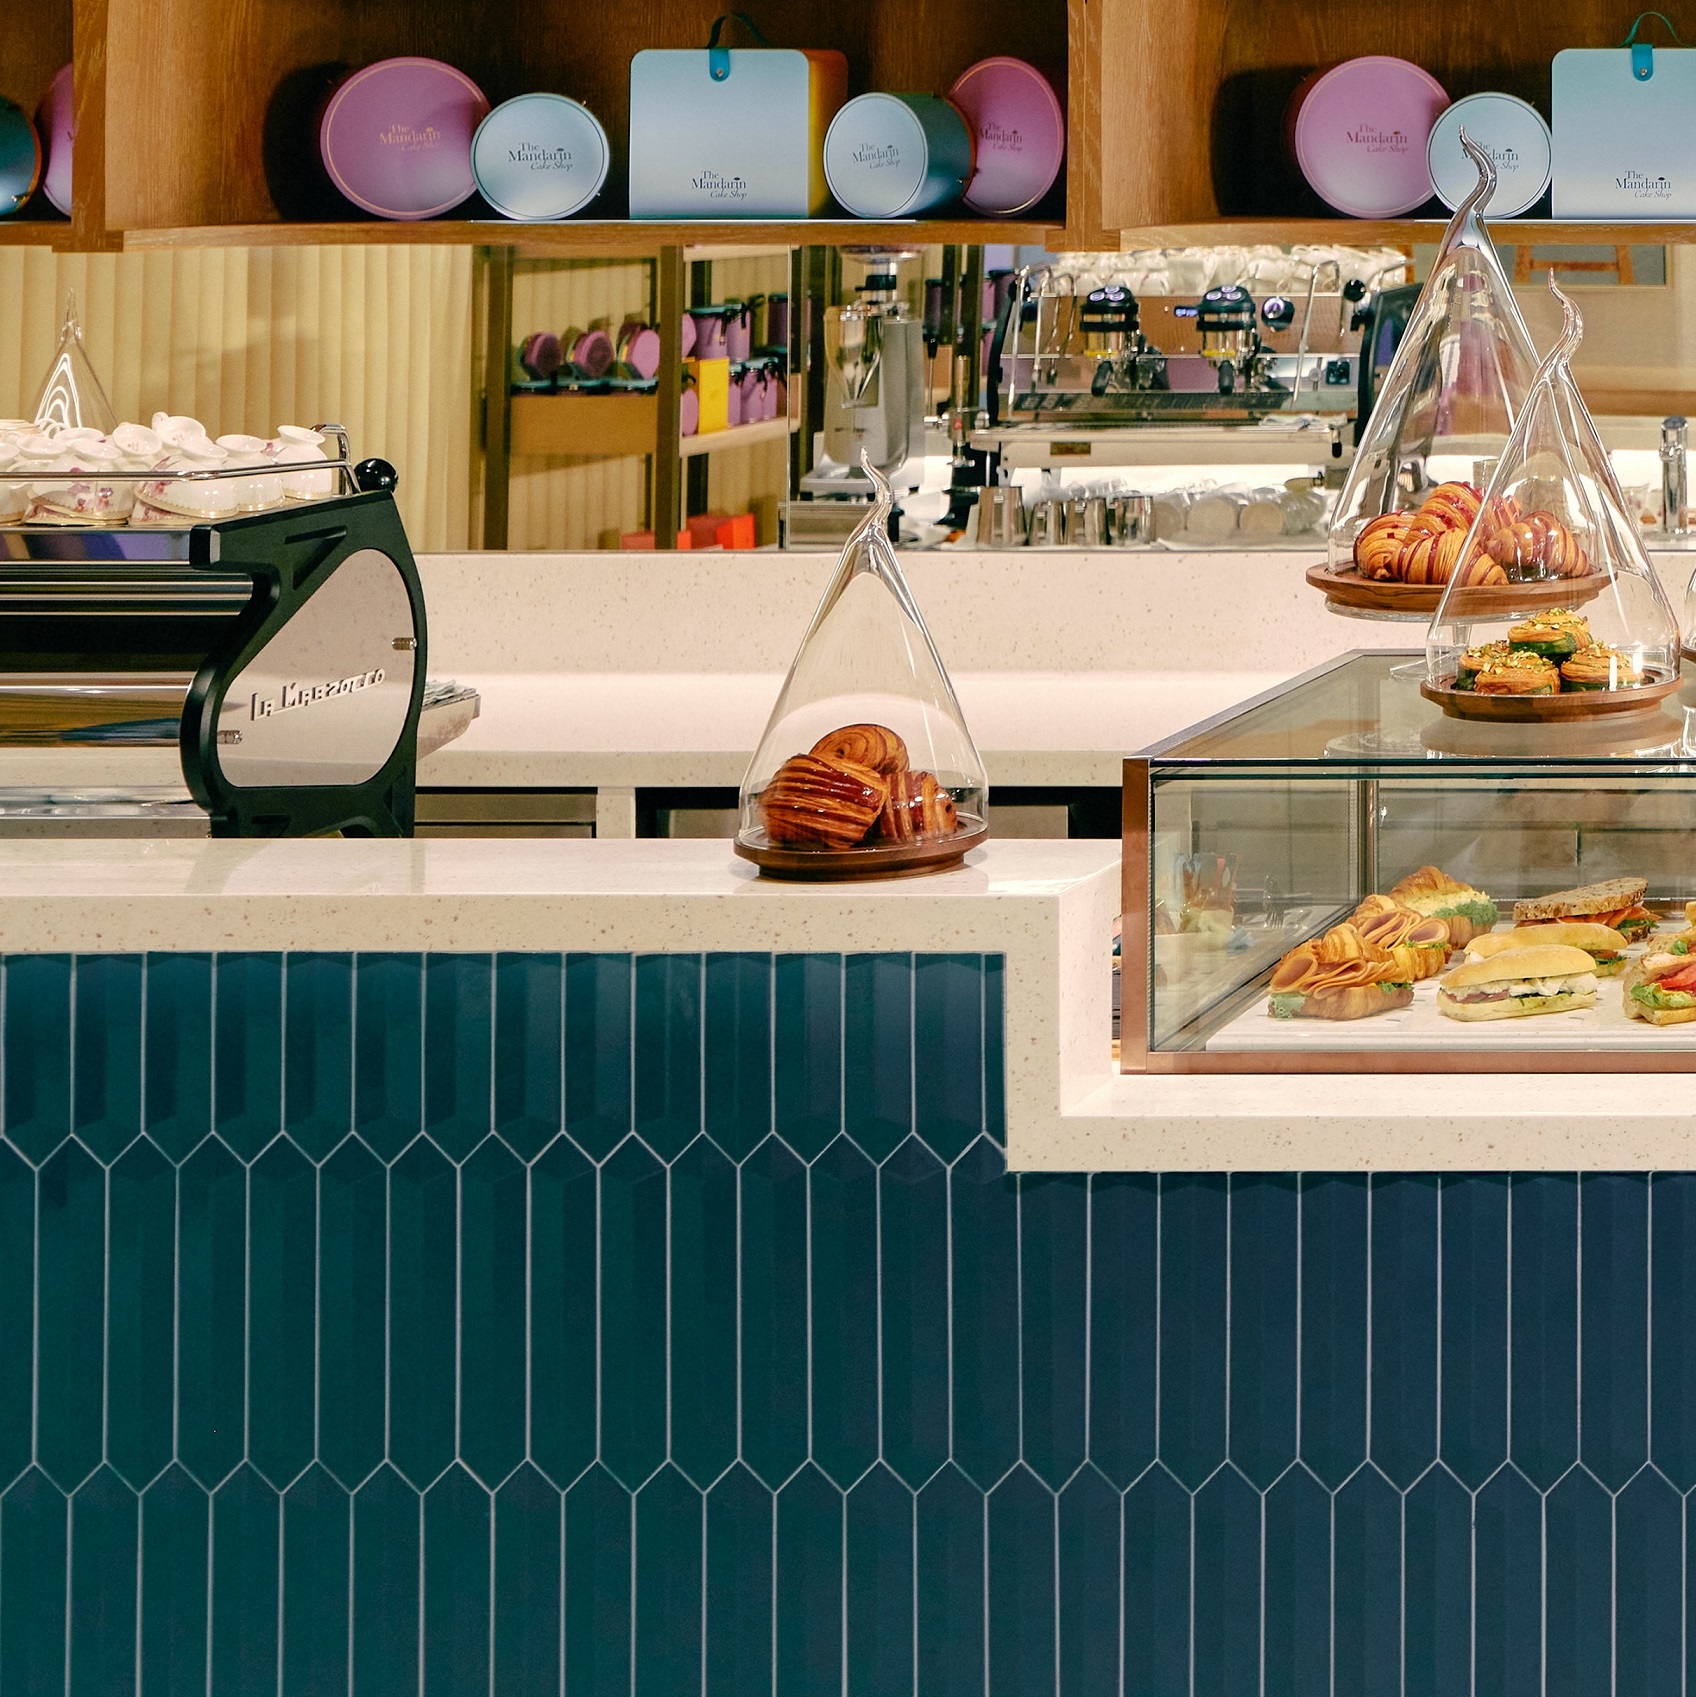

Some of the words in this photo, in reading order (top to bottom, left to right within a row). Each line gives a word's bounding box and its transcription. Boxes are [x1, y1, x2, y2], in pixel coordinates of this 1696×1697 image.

[390, 123, 409, 134] The
[987, 122, 1001, 132] The
[1358, 124, 1377, 133] The
[379, 127, 440, 147] Mandarin
[979, 128, 1022, 144] Mandarin
[1346, 130, 1408, 145] Mandarin
[520, 142, 540, 151] The
[861, 142, 876, 153] The
[1367, 146, 1387, 154] Cake
[1389, 145, 1409, 156] Shop
[508, 147, 572, 163] Mandarin
[852, 144, 899, 165] Mandarin
[530, 162, 550, 171] Cake
[552, 161, 573, 172] Shop
[868, 161, 883, 171] Cake
[884, 158, 900, 170] Shop
[1500, 161, 1519, 172] Shop
[702, 171, 719, 179] The
[1625, 170, 1643, 179] The
[692, 176, 746, 190] Mandarin
[1615, 176, 1672, 190] Mandarin
[710, 191, 728, 199] Cake
[729, 190, 747, 200] Shop
[1634, 191, 1652, 199] Cake
[1654, 190, 1672, 200] Shop
